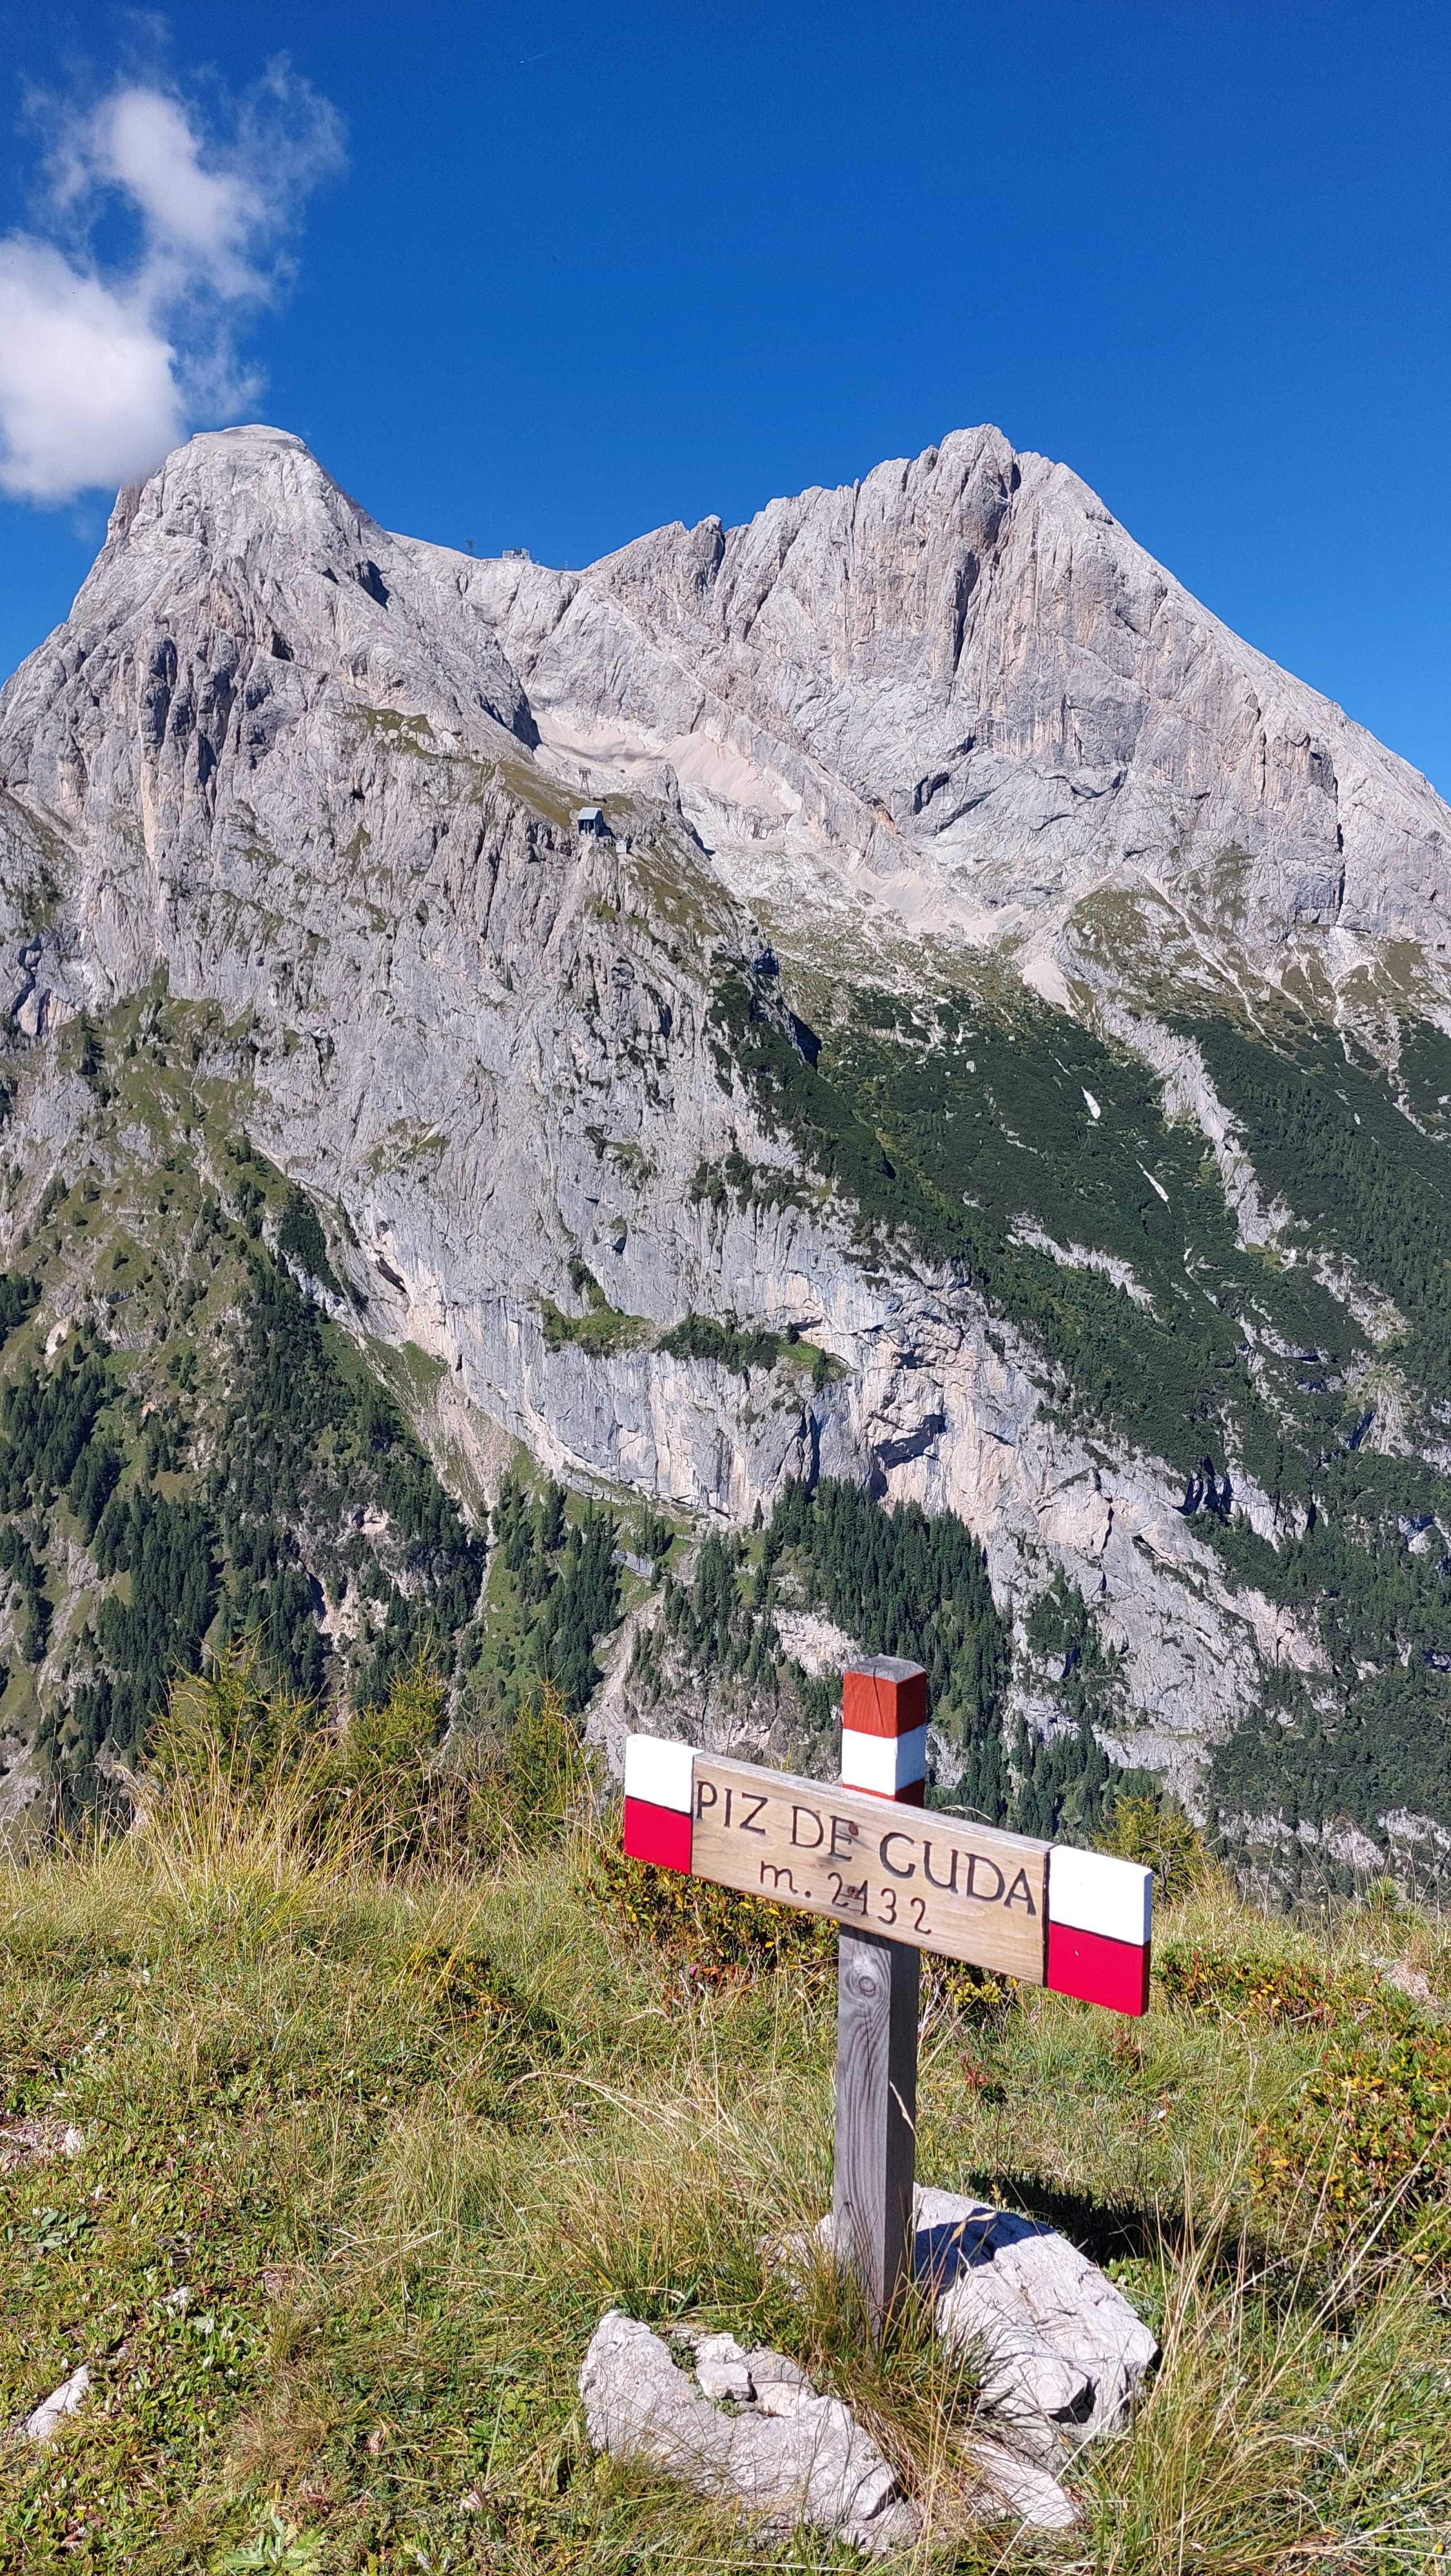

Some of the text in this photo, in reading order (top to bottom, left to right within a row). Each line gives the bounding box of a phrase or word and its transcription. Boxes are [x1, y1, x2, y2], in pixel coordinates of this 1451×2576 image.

[696, 1781, 1036, 1916] PIZ DE GUDA
[759, 1861, 811, 1898] m.
